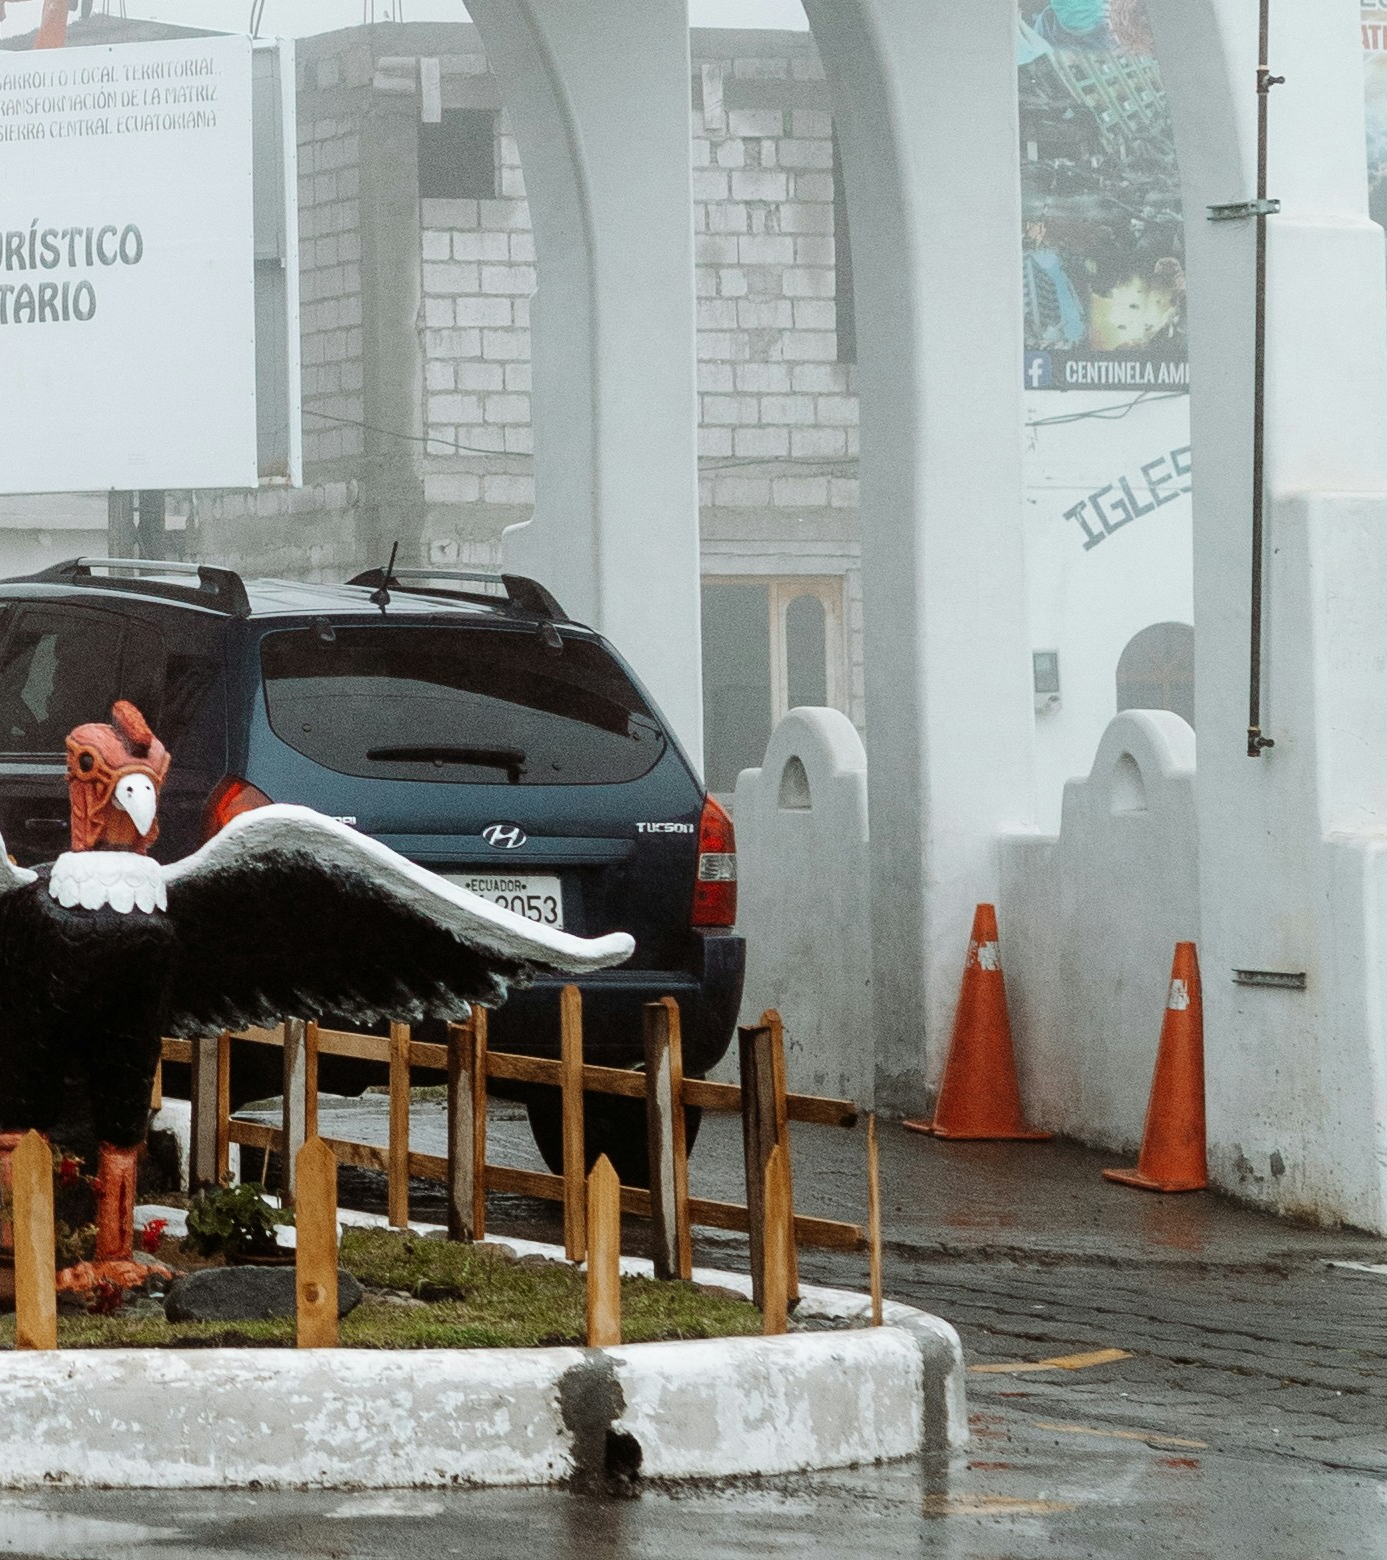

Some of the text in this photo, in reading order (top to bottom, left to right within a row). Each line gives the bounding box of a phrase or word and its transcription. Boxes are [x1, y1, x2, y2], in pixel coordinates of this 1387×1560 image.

[73, 65, 118, 86] LOCAL
[121, 89, 139, 108] DE
[143, 86, 161, 106] LA
[165, 83, 218, 104] MATRIZ
[50, 117, 112, 138] CENTRAL
[1065, 361, 1155, 384] CENTINELA
[636, 822, 694, 833] TUCSON
